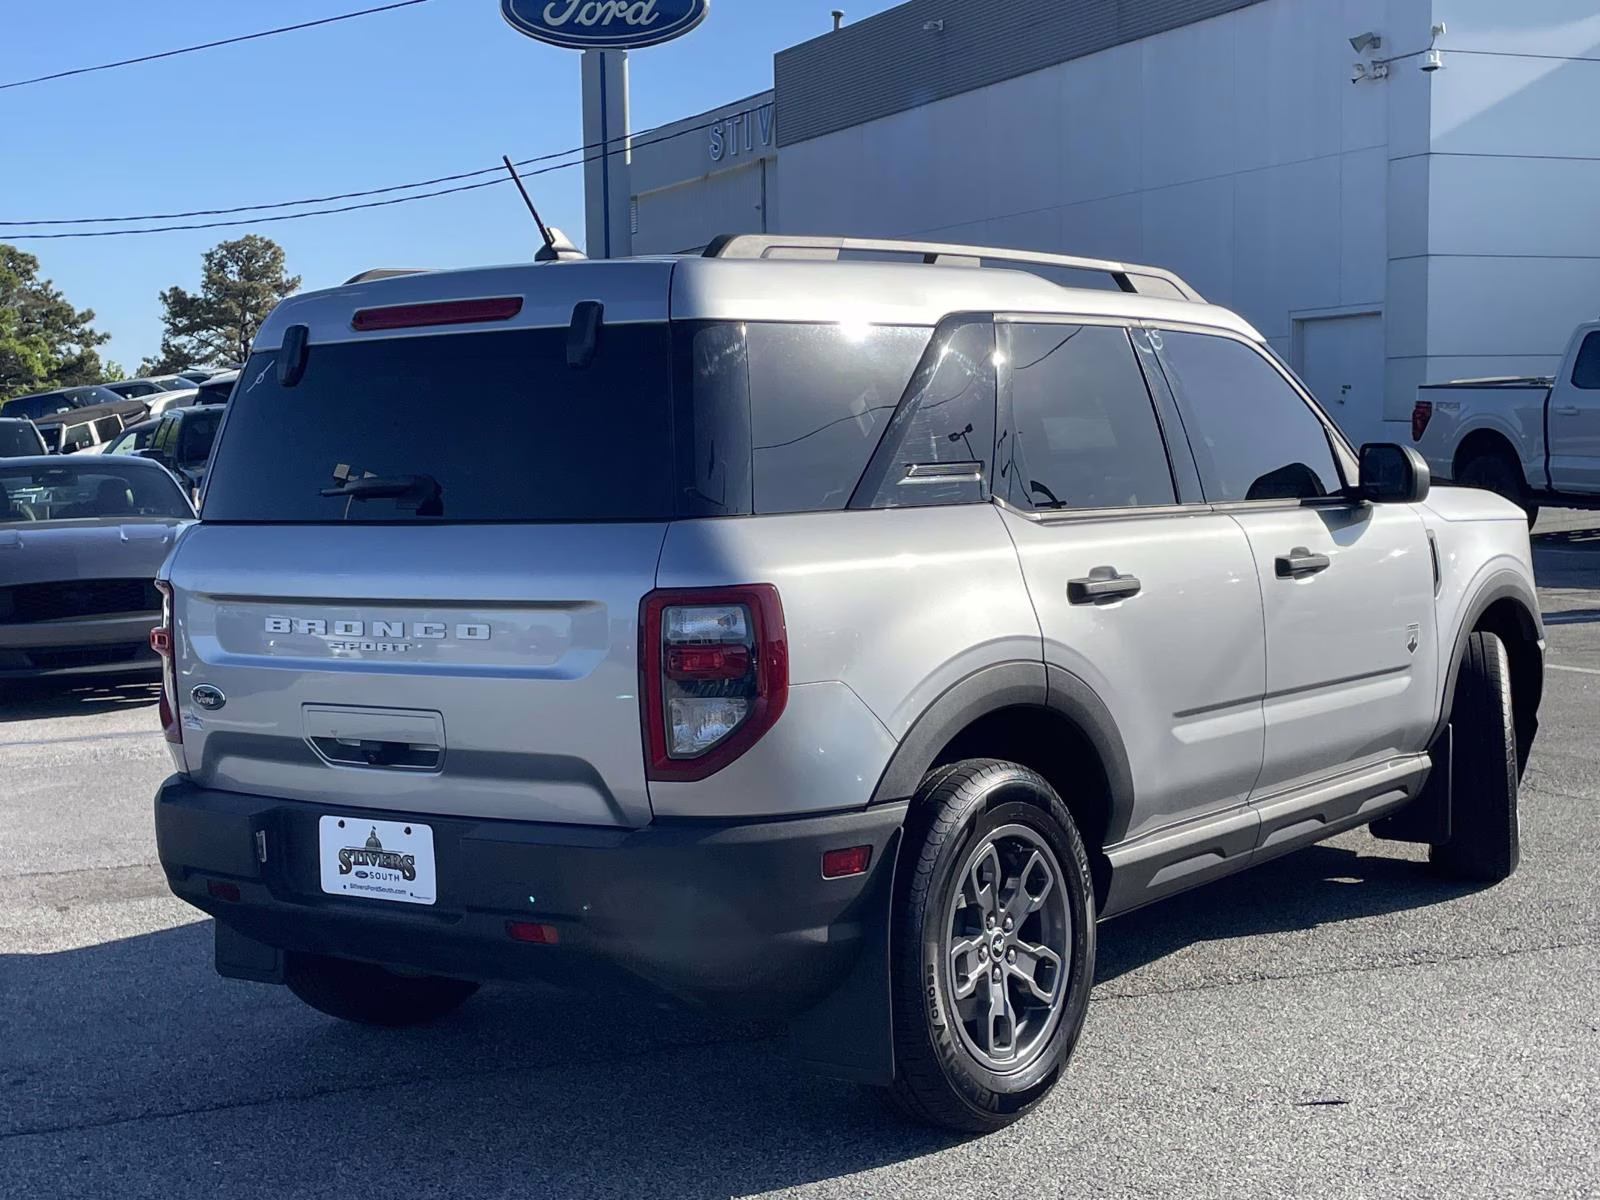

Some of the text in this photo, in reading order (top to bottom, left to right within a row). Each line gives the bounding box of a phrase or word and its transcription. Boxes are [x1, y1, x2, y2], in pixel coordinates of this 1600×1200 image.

[542, 0, 660, 27] Ford
[265, 617, 491, 640] BRONCO
[328, 640, 414, 653] SPORT
[338, 848, 417, 882] STIVERS
[369, 872, 401, 883] SOUTH
